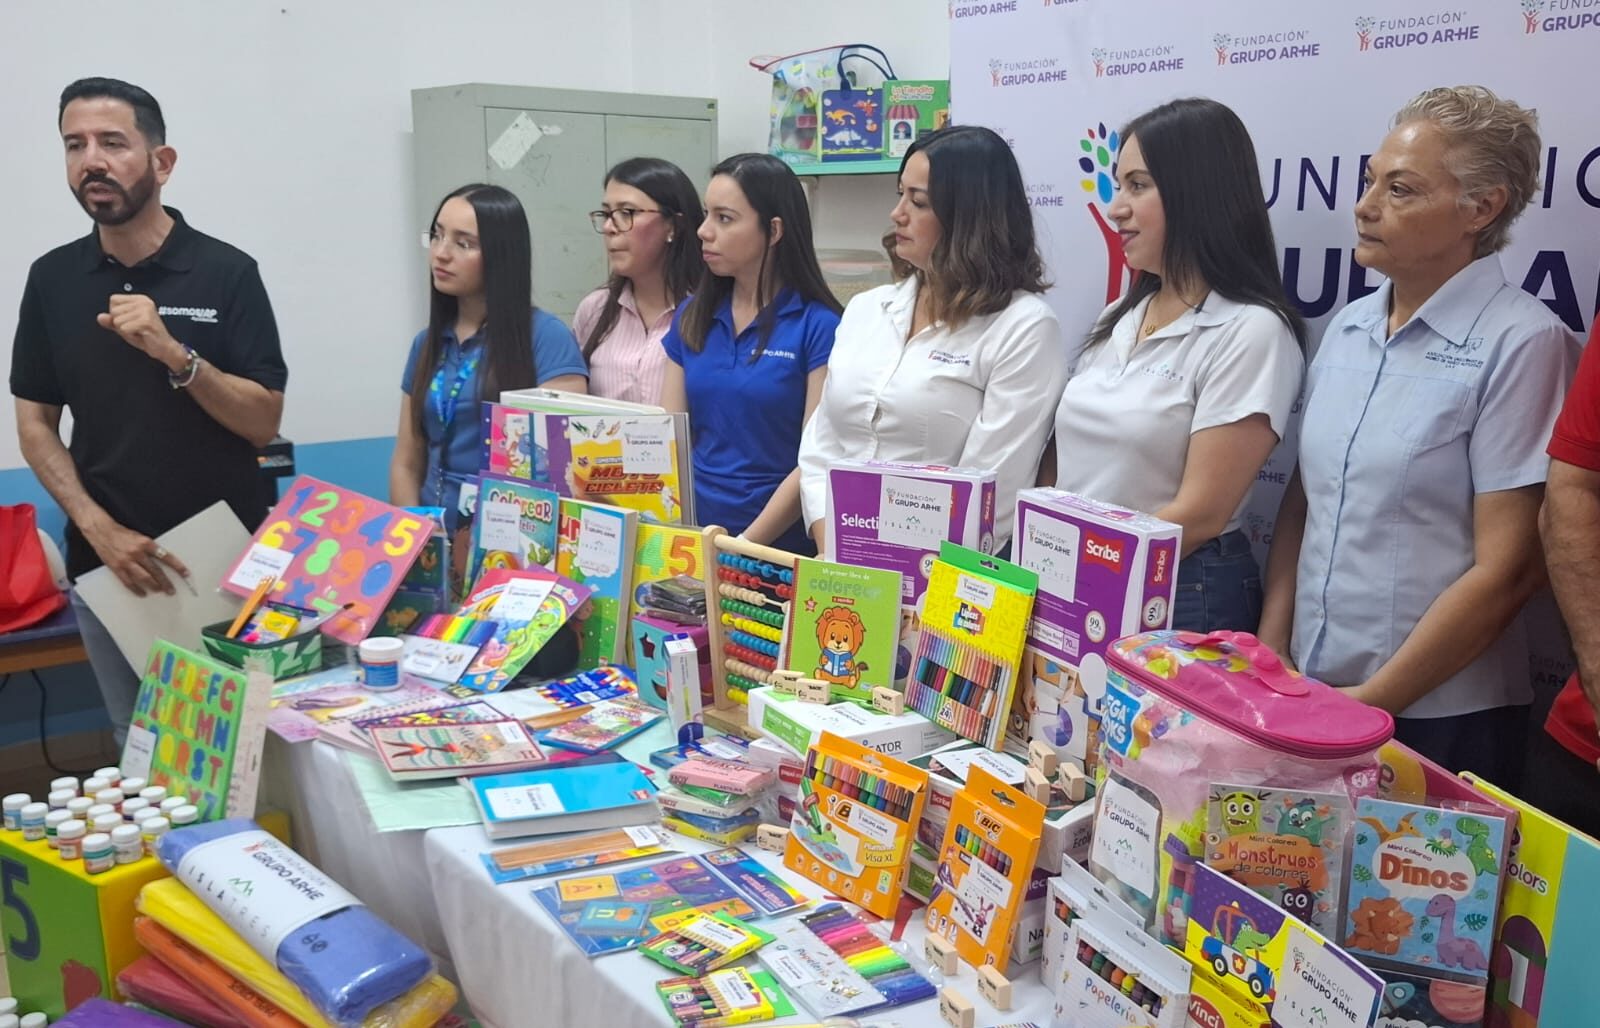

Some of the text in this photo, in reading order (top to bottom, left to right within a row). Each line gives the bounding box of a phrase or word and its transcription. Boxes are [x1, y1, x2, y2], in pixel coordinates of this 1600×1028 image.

[955, 5, 988, 18] GRUPO
[1379, 10, 1463, 32] FUNDACIÓN
[1234, 29, 1305, 47] FUNDACIÓN
[1373, 31, 1428, 50] GRUPO
[1109, 46, 1171, 60] FUNDACIÓN
[1229, 48, 1277, 64] GRUPO
[1106, 63, 1147, 77] GRUPO
[1001, 74, 1036, 86] GRUPO
[894, 498, 920, 509] GRUPO
[1034, 537, 1054, 550] GRUPO
[1085, 538, 1121, 563] Scribe
[1153, 549, 1167, 583] Scribe
[981, 816, 1001, 833] BIC
[1109, 811, 1135, 831] GRUPO
[1228, 841, 1318, 869] Monstruos
[1386, 842, 1404, 853] Mini
[252, 851, 293, 878] GRUPO
[1378, 852, 1469, 893] Dinos
[1, 857, 41, 962] 5
[1301, 970, 1332, 1000] GRUPO
[1084, 977, 1138, 1025] Papelería
